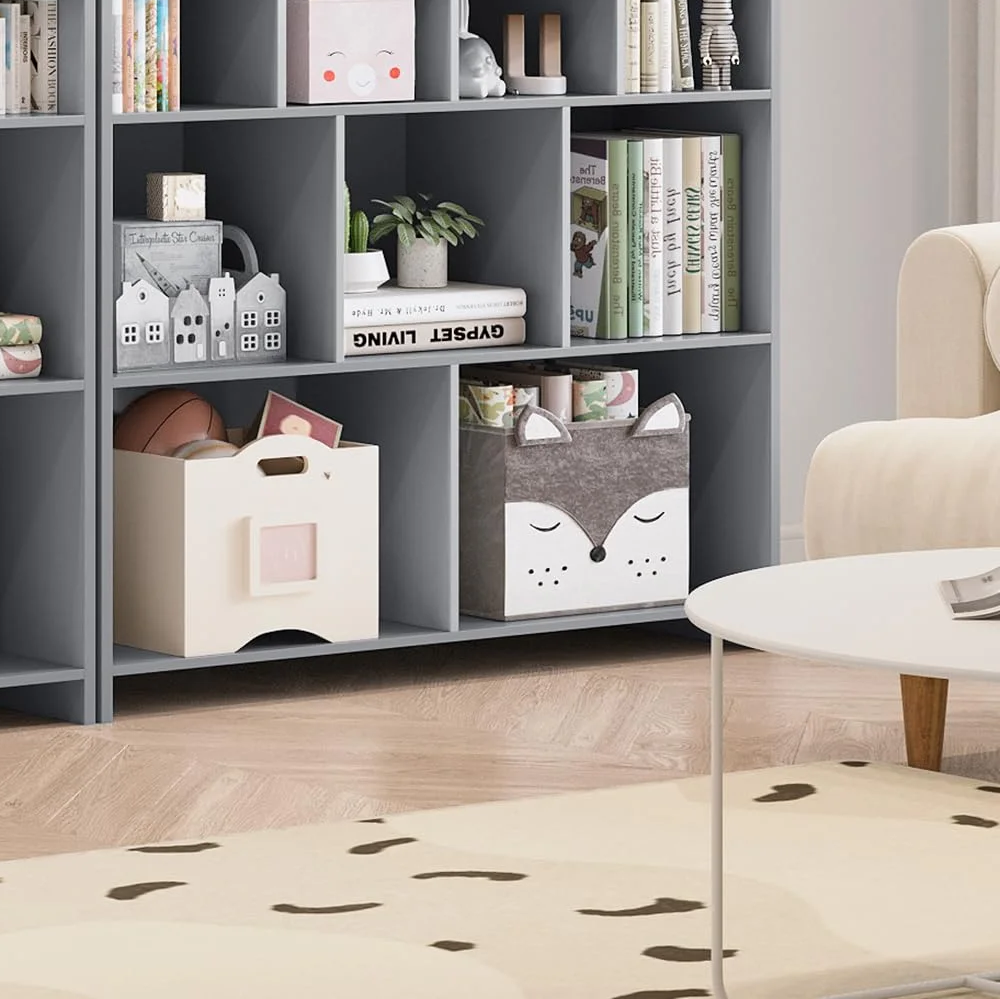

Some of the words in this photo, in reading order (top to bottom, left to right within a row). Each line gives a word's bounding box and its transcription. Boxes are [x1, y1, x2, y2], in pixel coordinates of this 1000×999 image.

[47, 2, 58, 26] THE
[679, 26, 688, 42] THE
[47, 27, 58, 76] FASHION
[680, 43, 691, 70] SHACK
[47, 79, 58, 112] BOOK
[351, 309, 373, 318] Hyde
[377, 307, 392, 316] Mr.
[353, 329, 417, 348] LIVING
[430, 324, 504, 343] GYPSET
